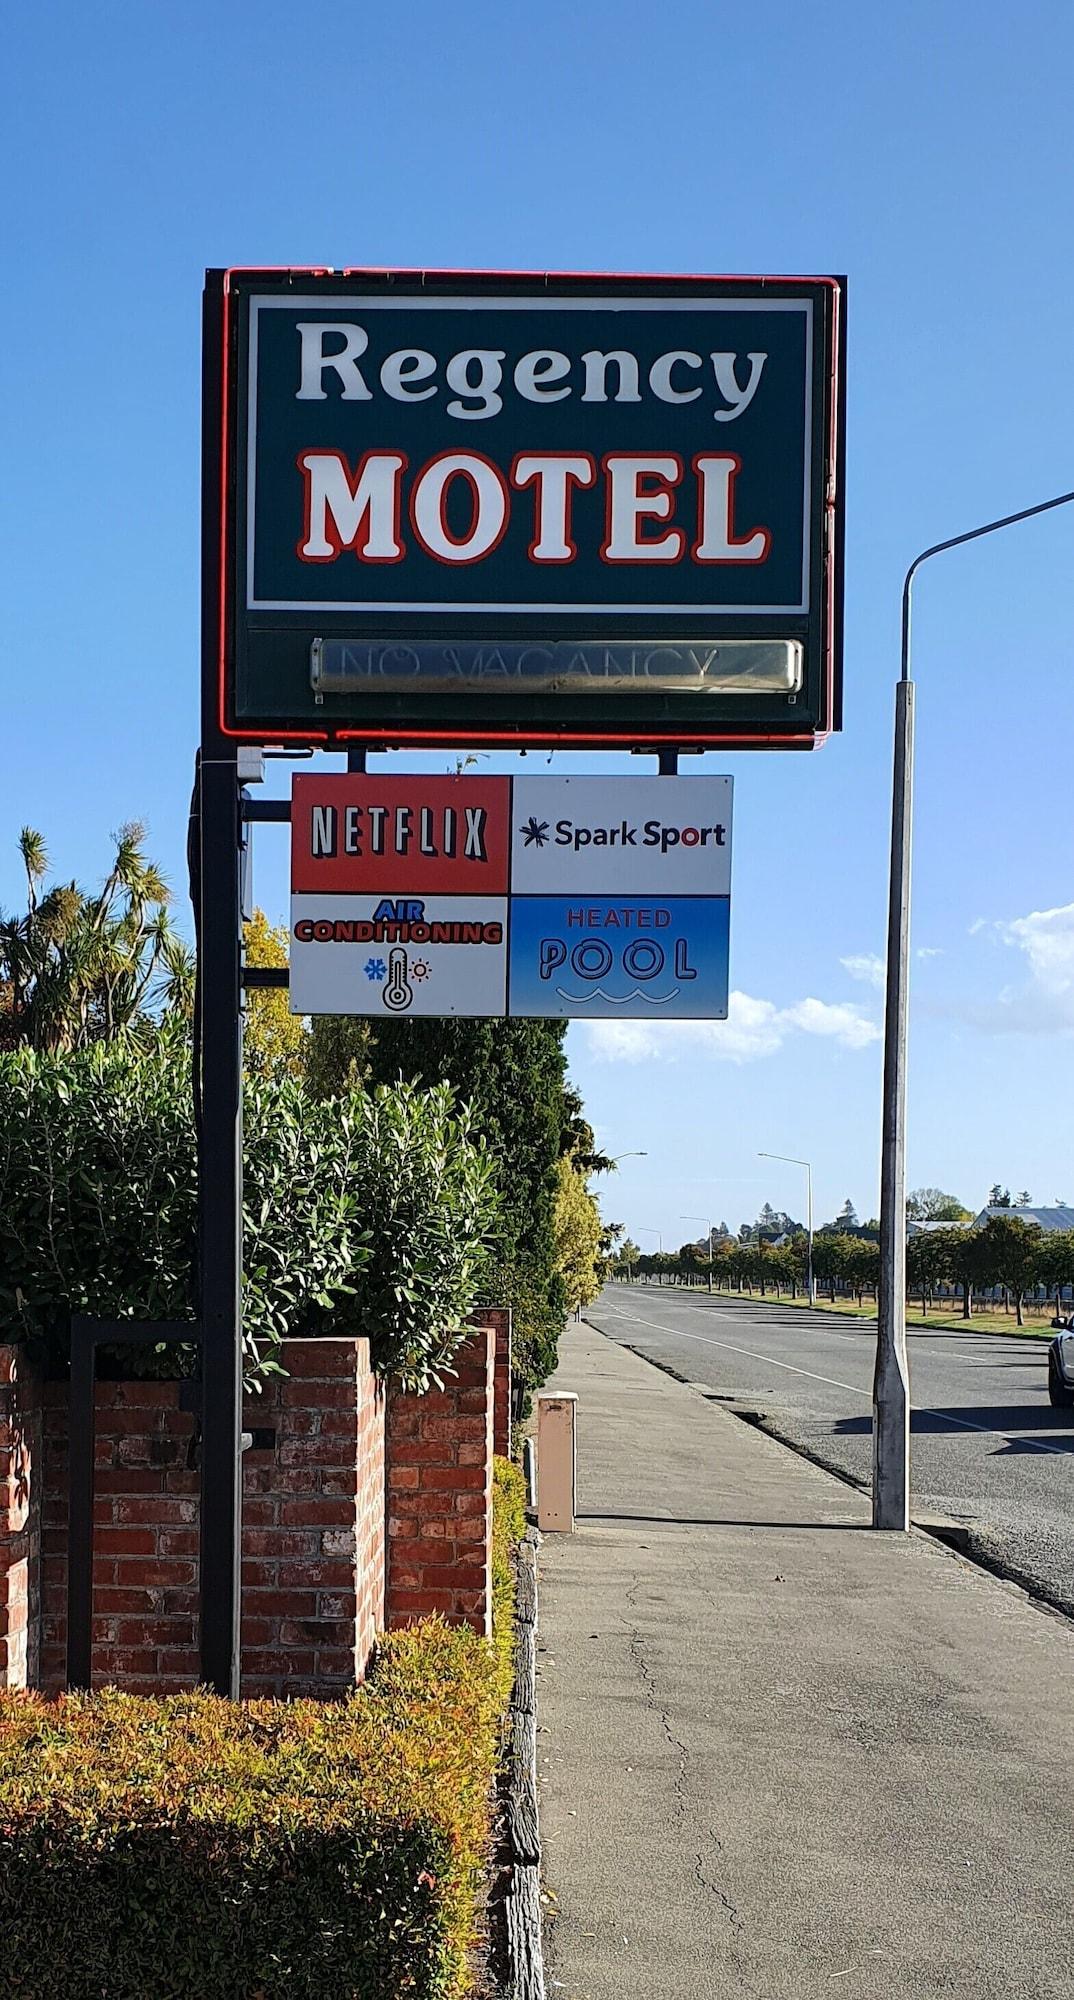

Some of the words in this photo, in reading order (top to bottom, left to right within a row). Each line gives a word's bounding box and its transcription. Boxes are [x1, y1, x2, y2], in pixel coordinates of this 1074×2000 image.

[295, 322, 768, 422] Regency
[297, 448, 771, 565] MOTEL
[341, 646, 420, 677] NO
[443, 648, 718, 679] VACANCY
[311, 806, 487, 861] NETFLIX
[555, 821, 637, 851] Spark
[642, 821, 726, 852] Sport
[372, 900, 425, 922] AIR
[567, 908, 672, 928] HEATED
[294, 920, 503, 944] CONDITIONING
[540, 938, 697, 980] POOL
